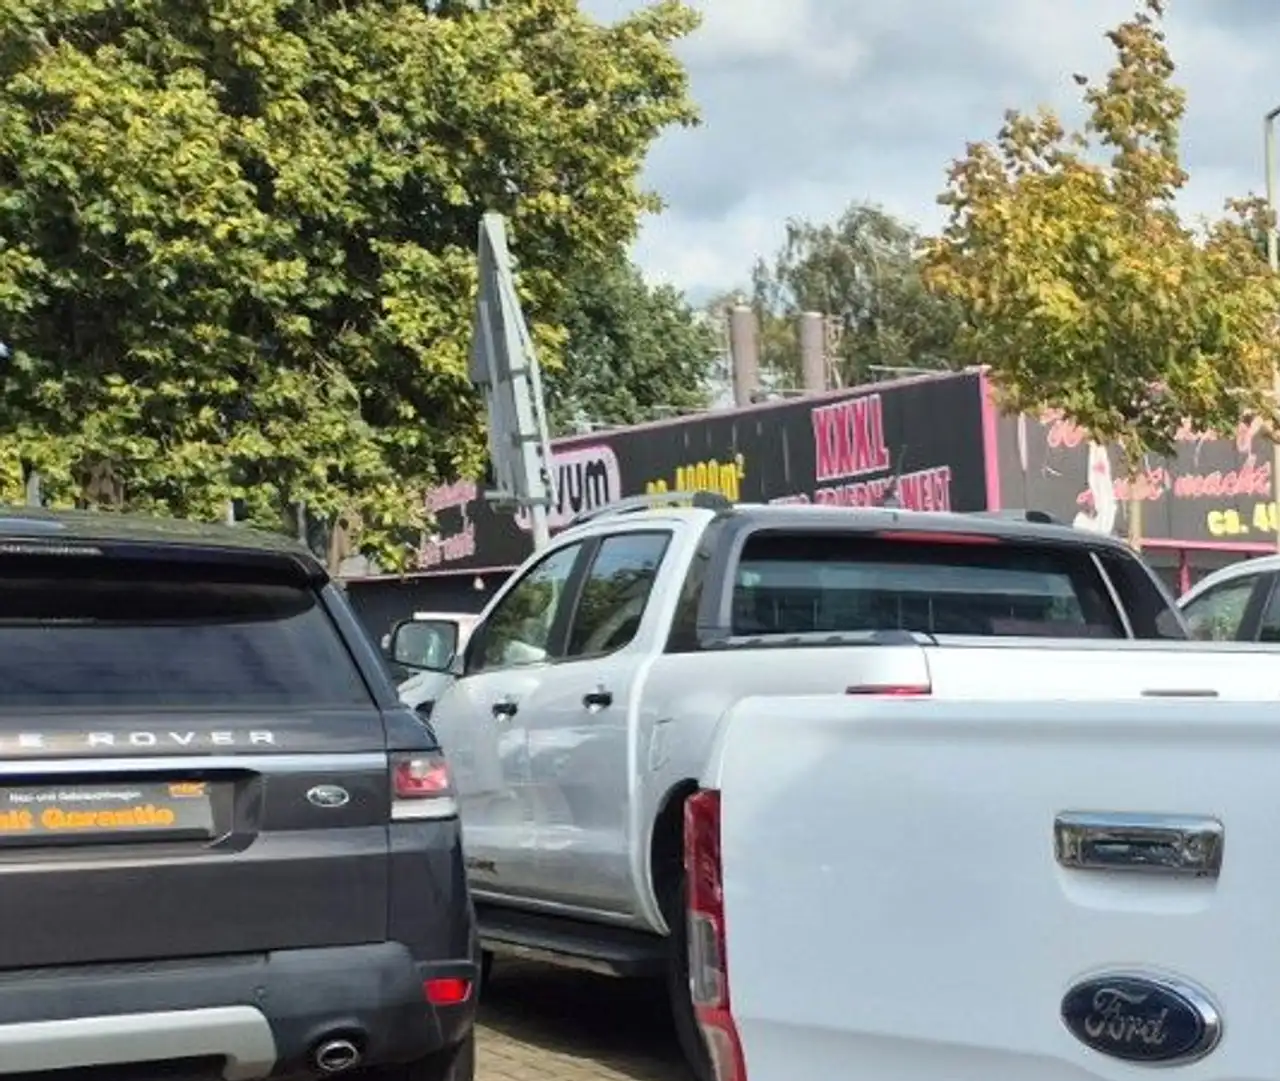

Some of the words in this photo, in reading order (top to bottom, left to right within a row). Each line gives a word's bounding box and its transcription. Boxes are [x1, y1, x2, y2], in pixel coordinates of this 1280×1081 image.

[812, 394, 890, 481] XXXL
[87, 731, 277, 748] ROVER
[1084, 987, 1169, 1045] Ford
